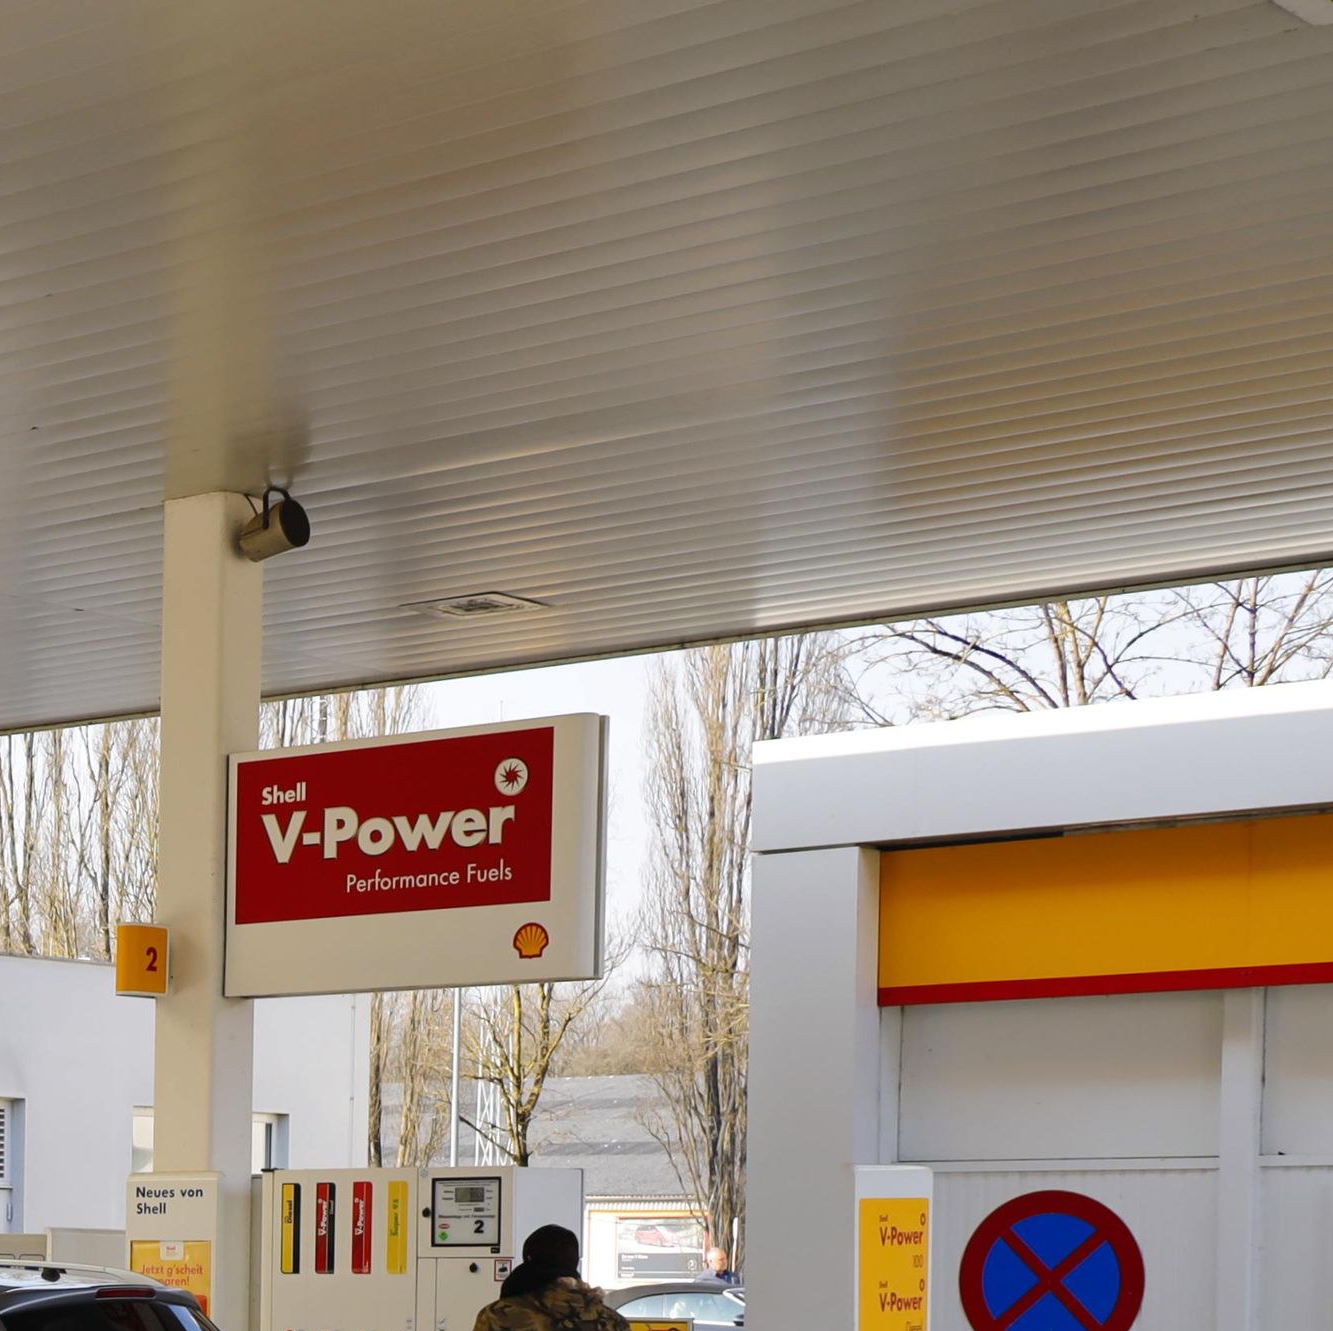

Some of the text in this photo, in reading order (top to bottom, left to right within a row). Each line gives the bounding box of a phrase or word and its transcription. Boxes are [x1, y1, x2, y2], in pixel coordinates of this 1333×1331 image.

[261, 781, 306, 806] Shell
[261, 805, 515, 864] V-Power
[346, 858, 512, 893] Performance Fuels
[146, 946, 158, 972] 2
[136, 1187, 203, 1198] Neues von
[136, 1203, 166, 1215] Shell
[474, 1220, 484, 1233] 2
[879, 1226, 923, 1246] V-Power
[142, 1264, 164, 1275] Jetzt
[879, 1292, 923, 1312] V-Power
